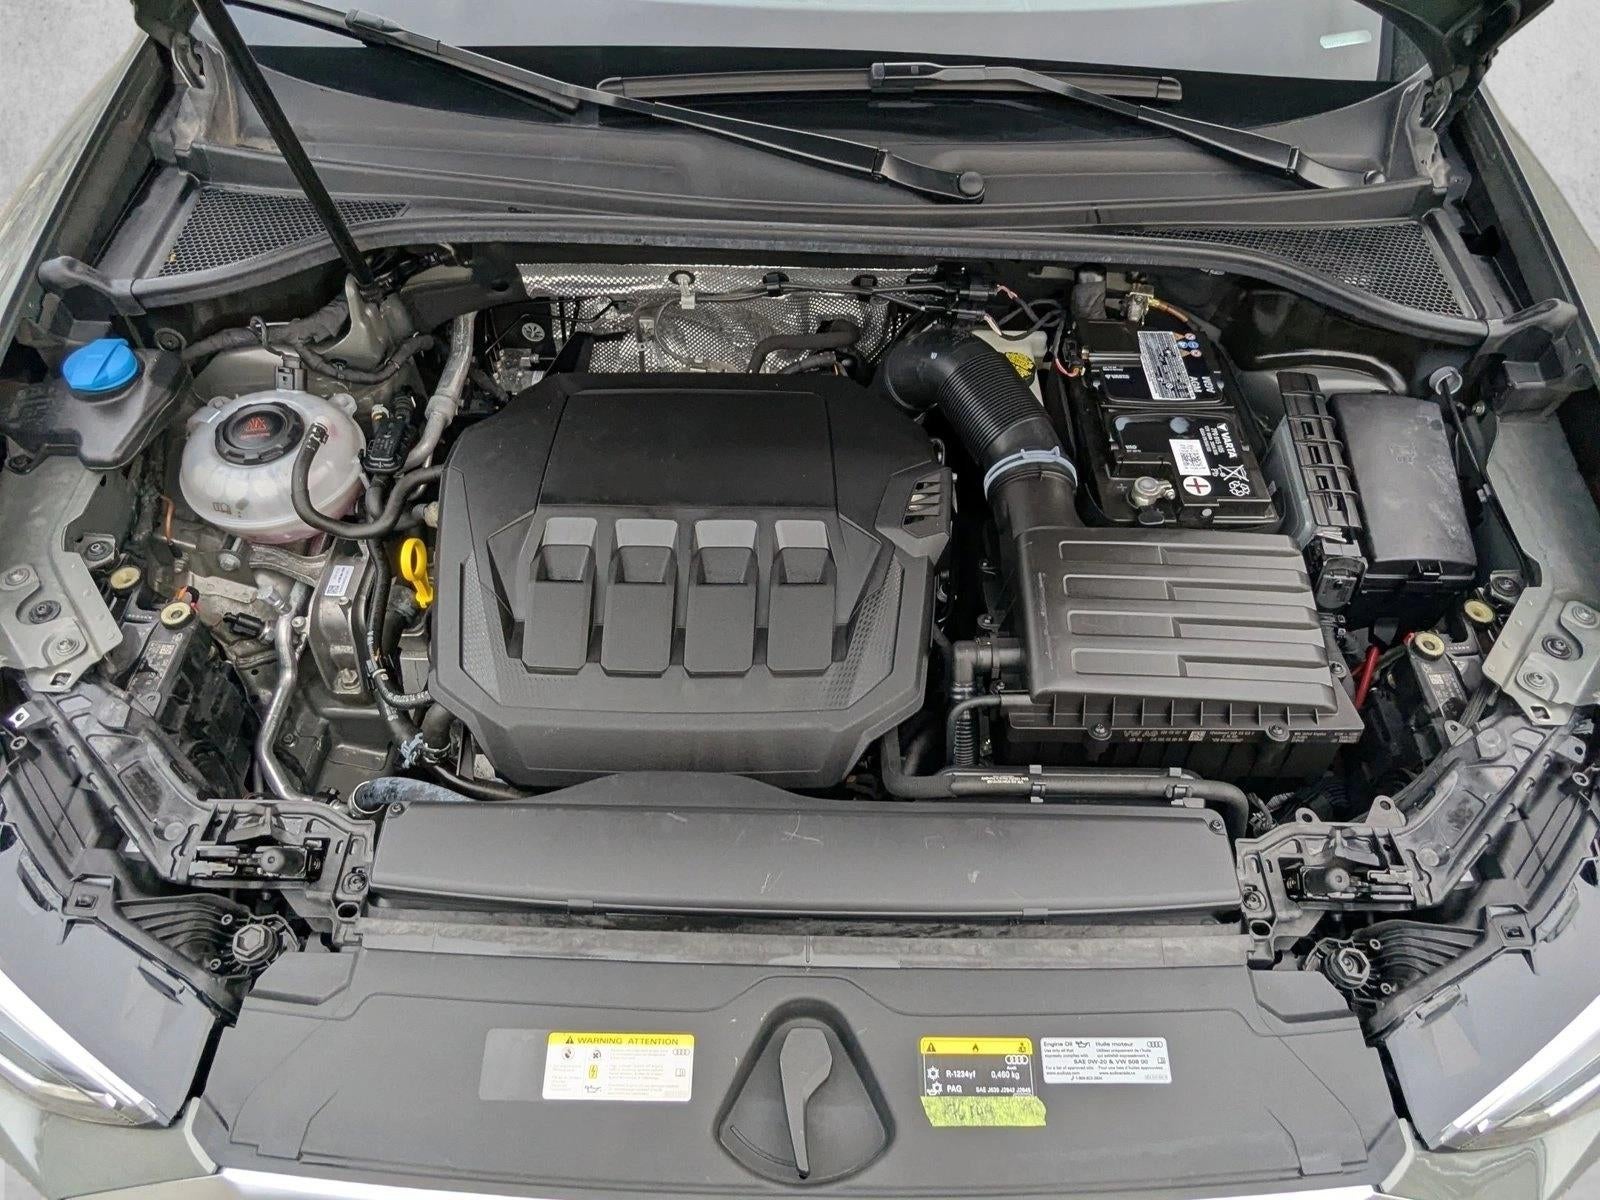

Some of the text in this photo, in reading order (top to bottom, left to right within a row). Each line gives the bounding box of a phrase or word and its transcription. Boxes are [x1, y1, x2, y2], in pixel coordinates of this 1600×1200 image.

[1220, 431, 1238, 459] VARTA
[945, 1070, 976, 1079] R-1234yf
[1011, 1070, 1020, 1080] kg
[947, 1085, 962, 1093] PAG
